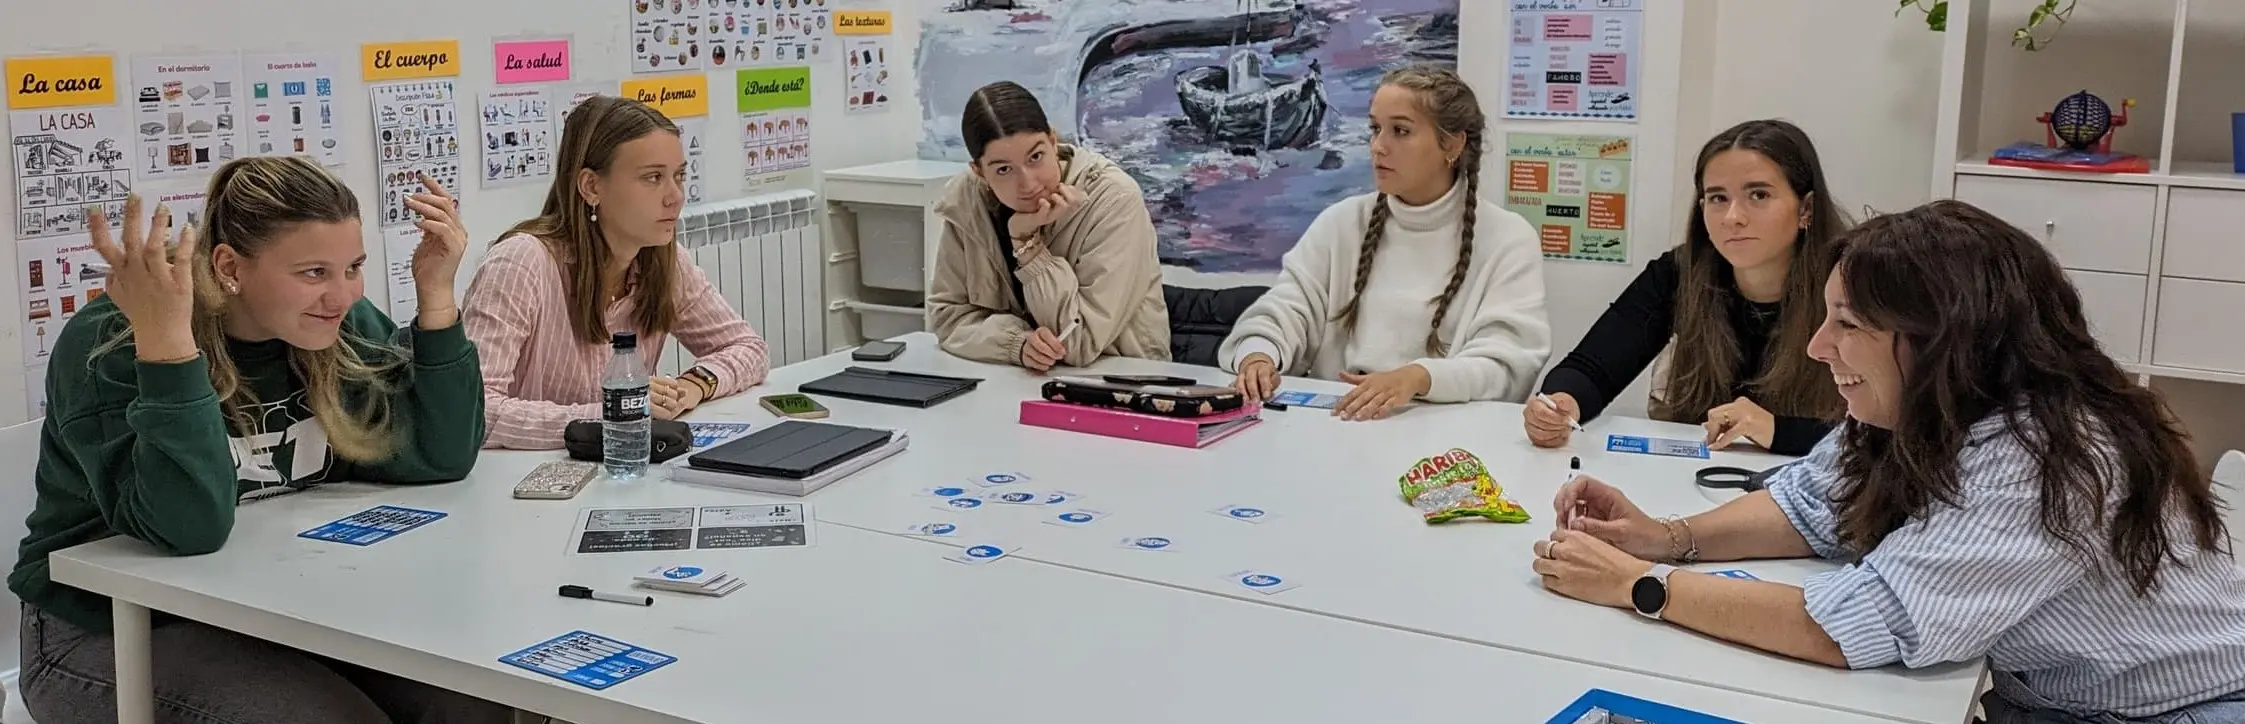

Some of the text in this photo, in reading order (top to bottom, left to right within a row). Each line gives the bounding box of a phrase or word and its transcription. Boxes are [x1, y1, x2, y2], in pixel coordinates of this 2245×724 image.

[839, 14, 854, 27] Las
[855, 15, 886, 27] texturas
[157, 64, 211, 73] En el dormitorio
[374, 50, 449, 71] El cuerpo
[504, 51, 563, 70] La salud
[19, 73, 102, 95] La casa
[781, 77, 805, 92] está?
[637, 86, 697, 106] Las formas
[39, 112, 96, 132] LA CASA
[57, 246, 69, 254] Los
